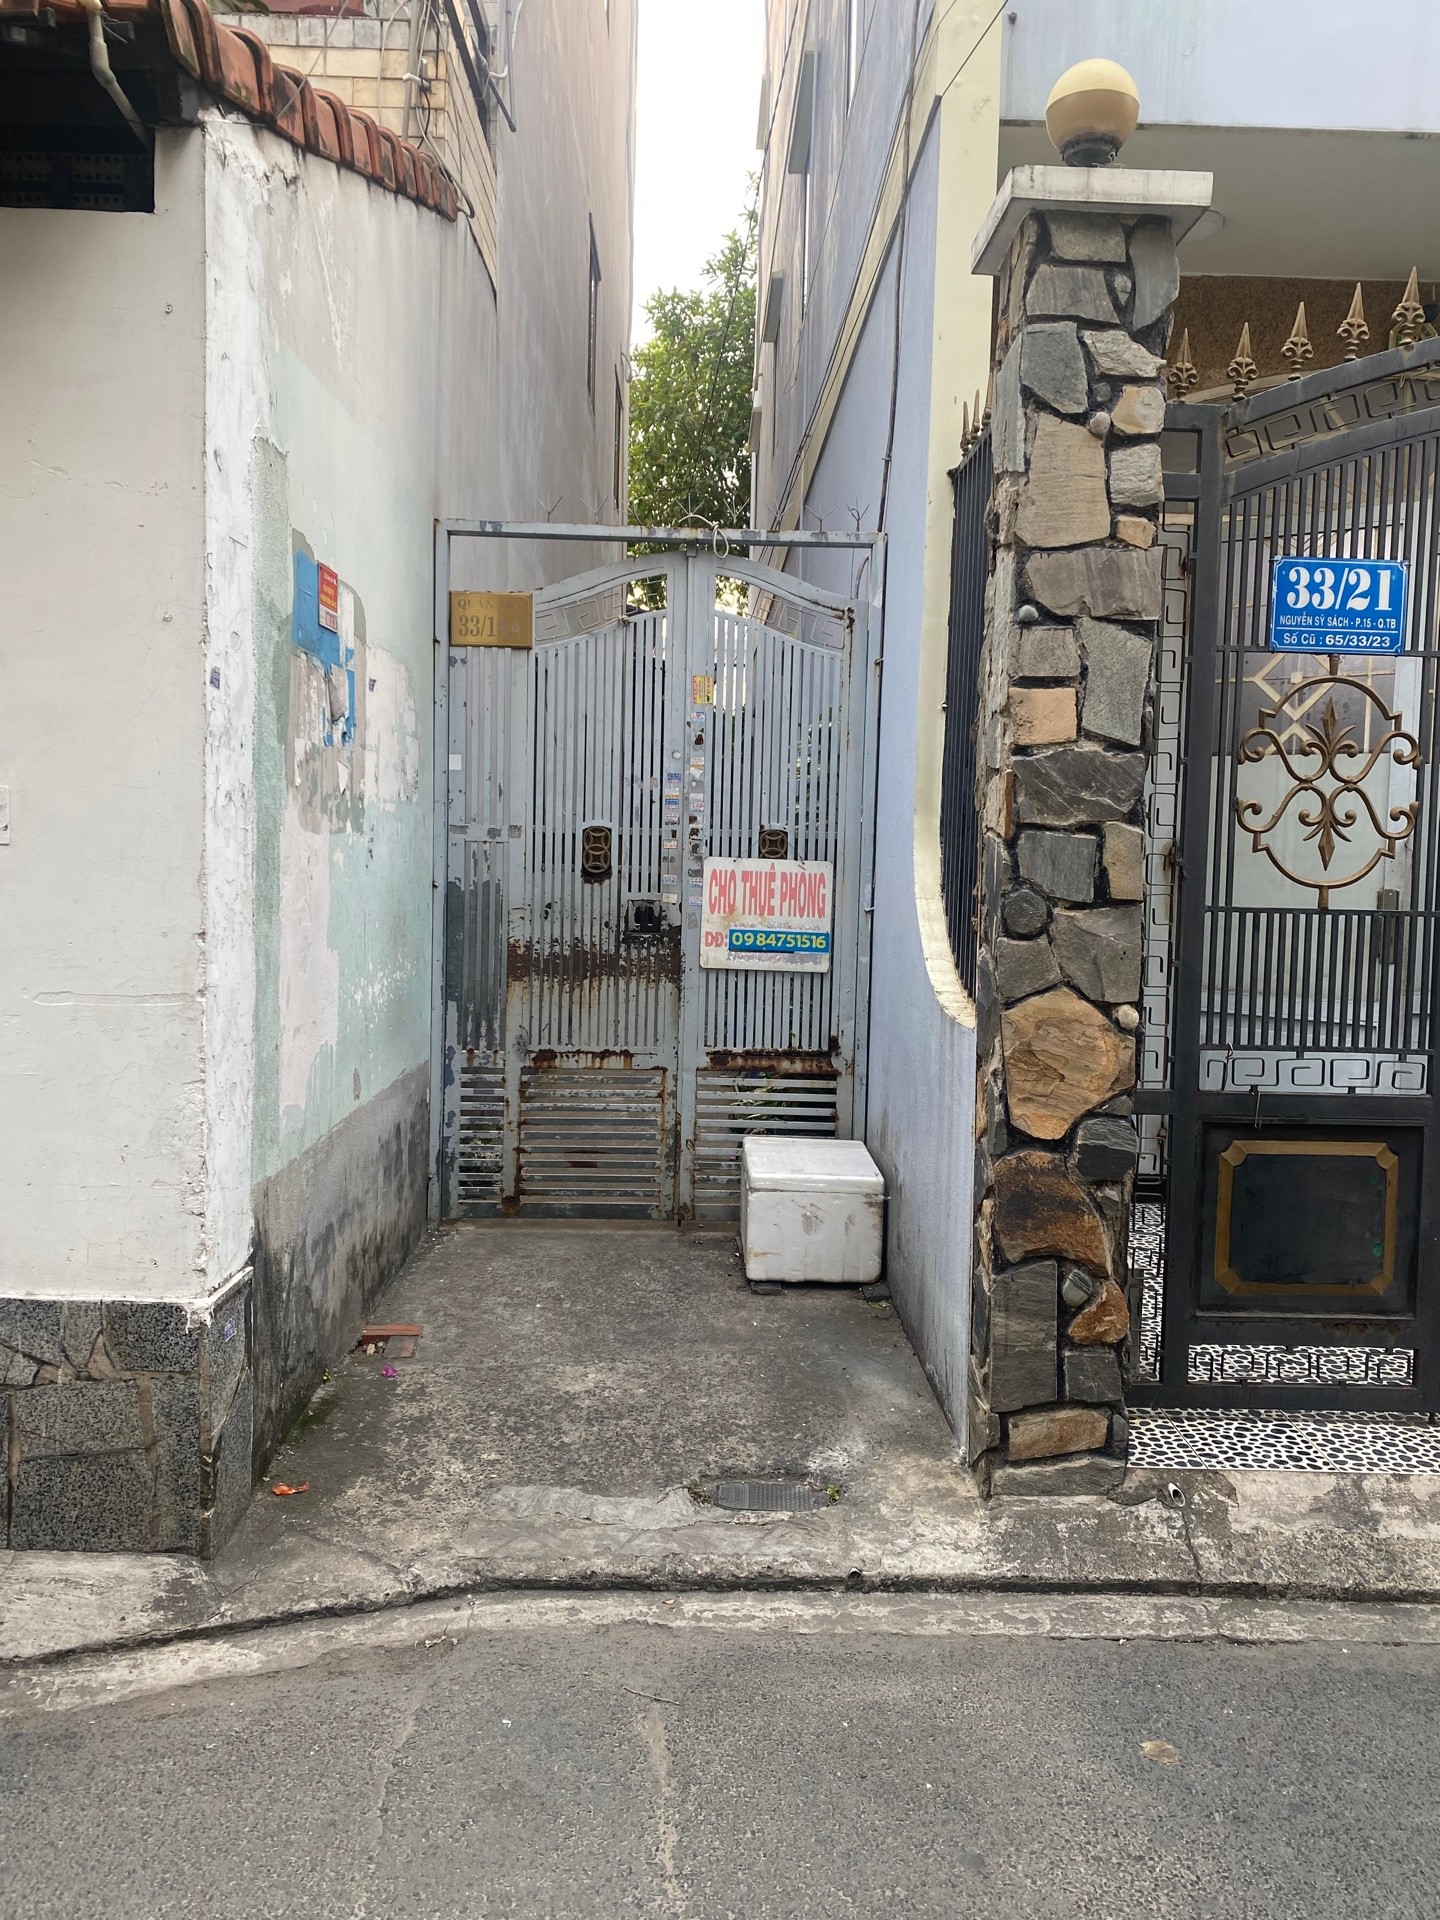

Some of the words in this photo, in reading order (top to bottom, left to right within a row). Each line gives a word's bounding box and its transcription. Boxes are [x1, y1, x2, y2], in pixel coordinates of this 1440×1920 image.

[1286, 566, 1393, 611] 33/21
[1279, 611, 1313, 626] NGUYỄN
[1327, 615, 1349, 627] SÁCH
[1355, 617, 1372, 628] P.15
[1377, 618, 1396, 629] Q.TB
[1283, 629, 1299, 644] Số
[1301, 632, 1316, 644] Cũ
[1325, 634, 1391, 647] 65/33/23
[708, 868, 737, 917] CHO
[741, 862, 776, 917] THUÊ
[779, 864, 826, 919] PHÒNG
